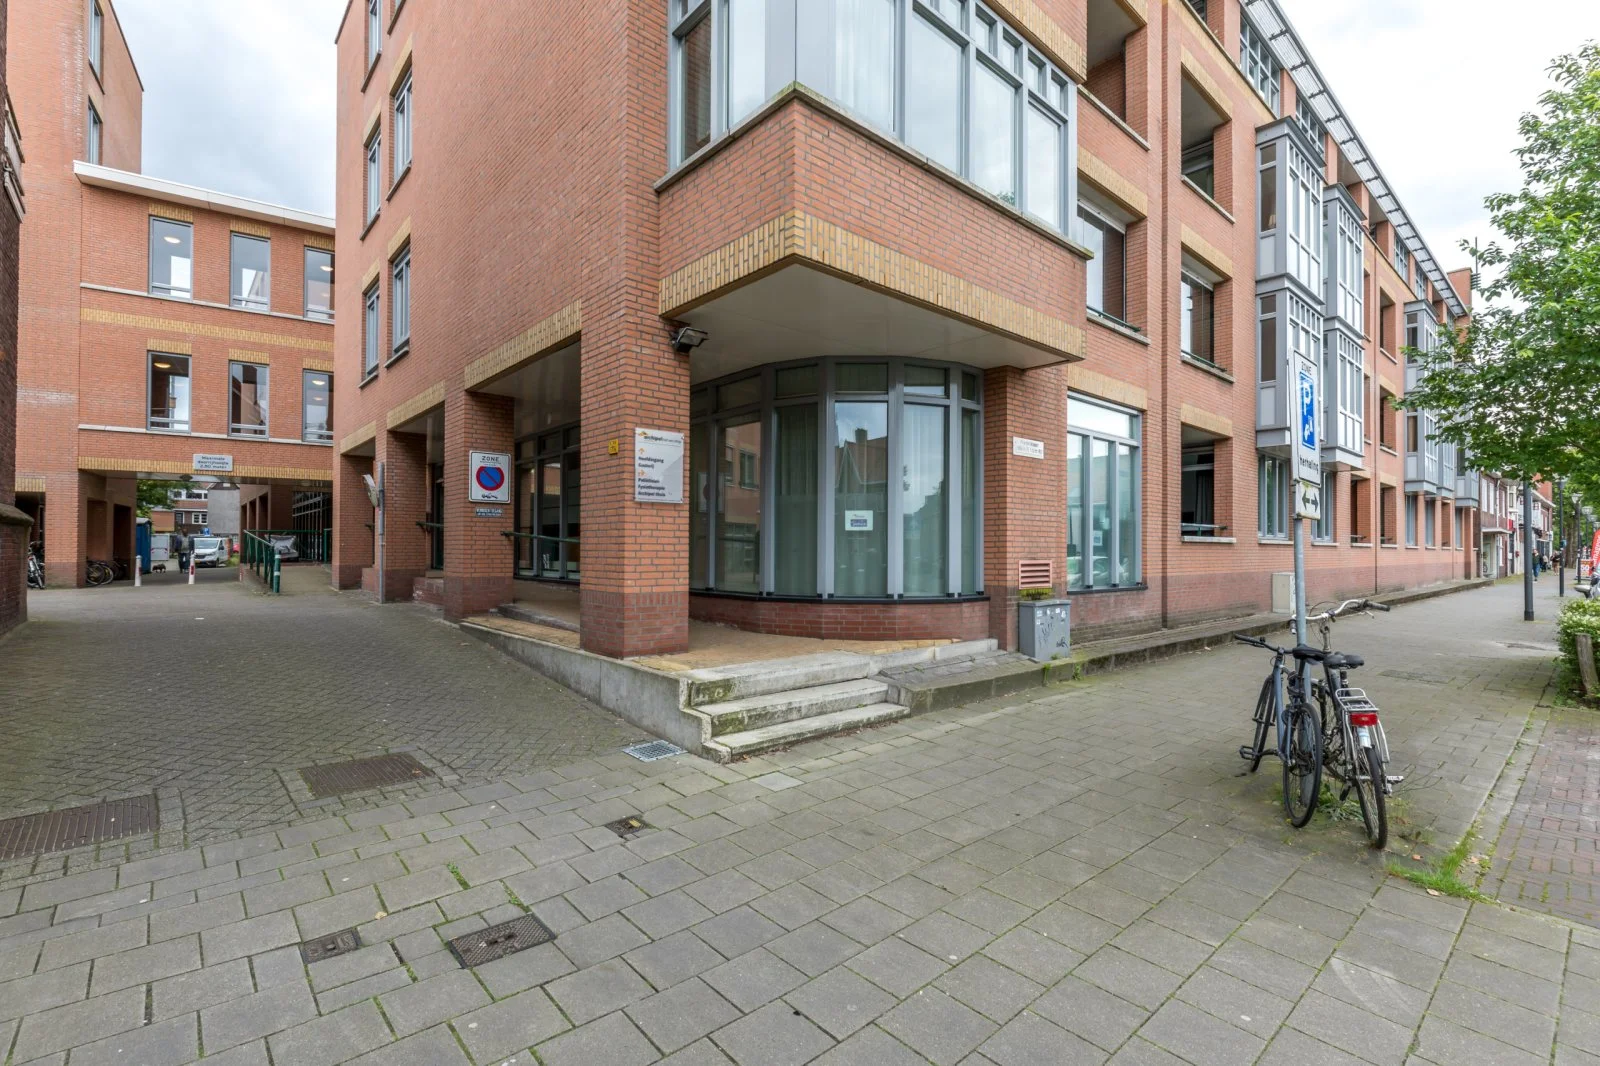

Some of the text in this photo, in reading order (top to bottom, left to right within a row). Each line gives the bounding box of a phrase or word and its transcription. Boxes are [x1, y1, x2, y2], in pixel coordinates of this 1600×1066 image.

[1301, 361, 1312, 376] ZONE
[1303, 382, 1311, 416] P
[1299, 454, 1319, 475] herhaling
